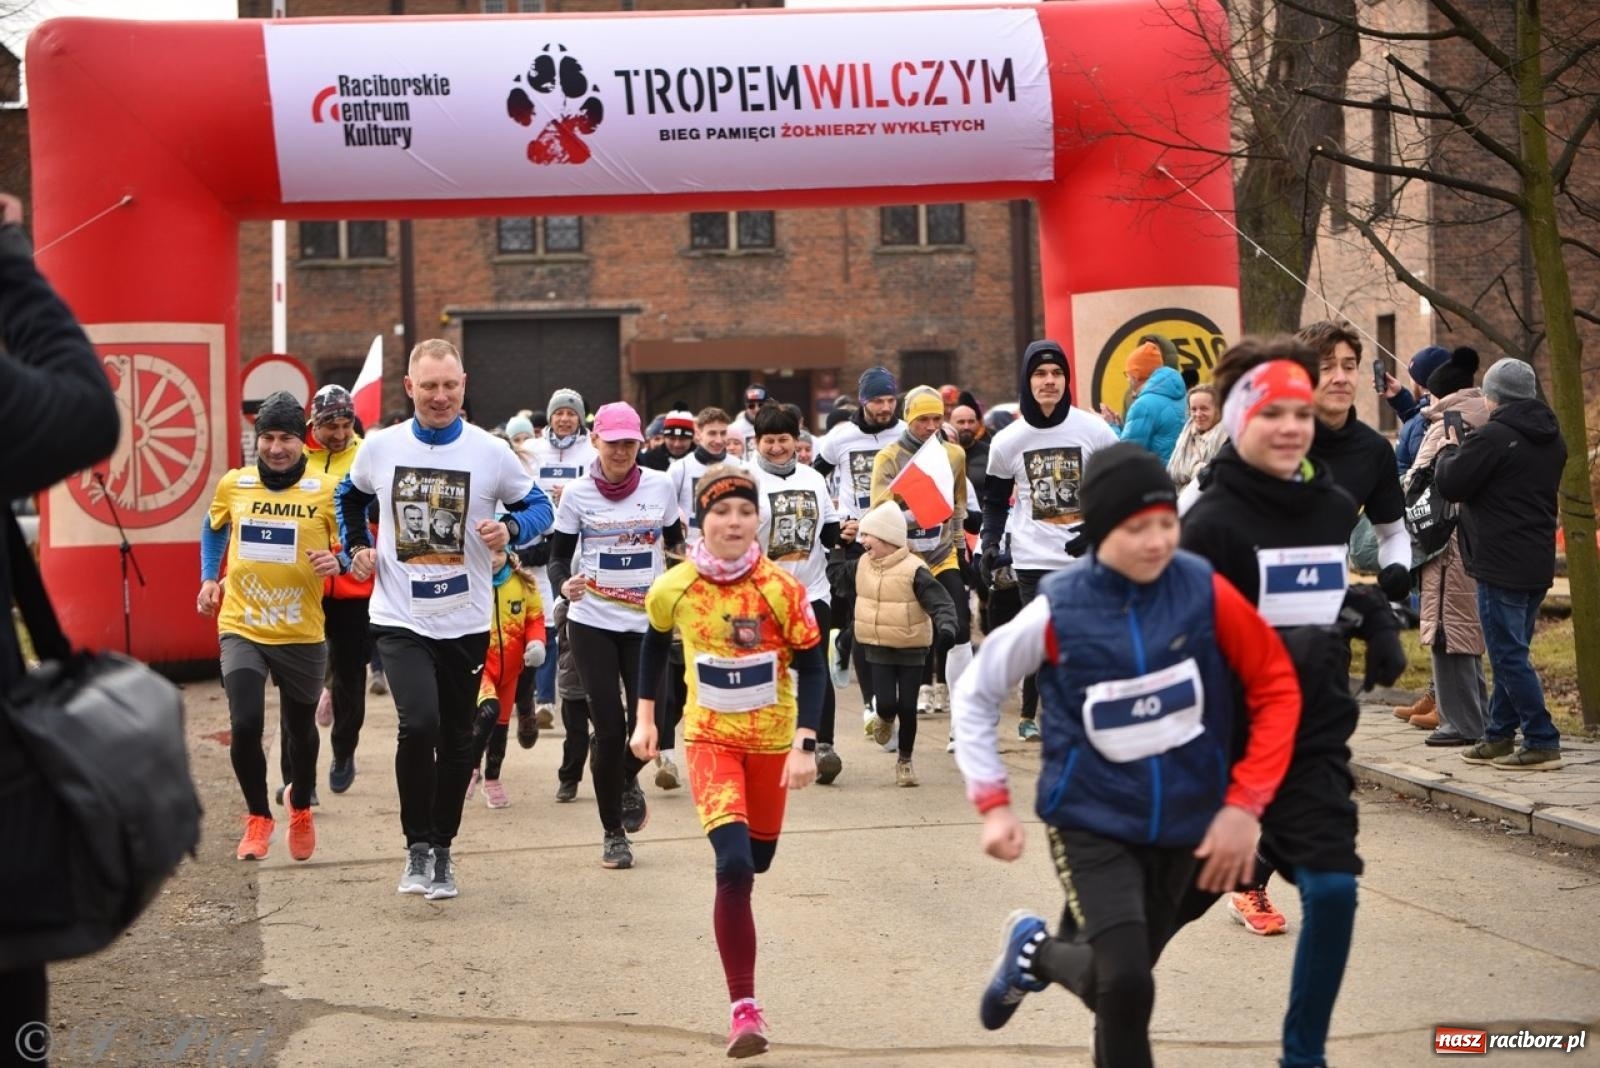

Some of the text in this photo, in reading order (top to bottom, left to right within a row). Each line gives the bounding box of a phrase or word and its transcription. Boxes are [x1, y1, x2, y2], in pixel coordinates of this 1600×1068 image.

[338, 73, 450, 97] Raciborskie
[344, 124, 412, 150] Kultury
[659, 119, 986, 142] BIEG PAMIĘCI ŻOŁNIERZY WYKLĘTYCH
[252, 501, 318, 519] FAMILY
[260, 529, 272, 540] 12
[620, 556, 632, 567] 17
[1296, 567, 1320, 586] 44
[434, 582, 449, 594] 39
[244, 603, 304, 626] LIFE
[727, 670, 741, 685] 11
[1130, 695, 1162, 718] 40
